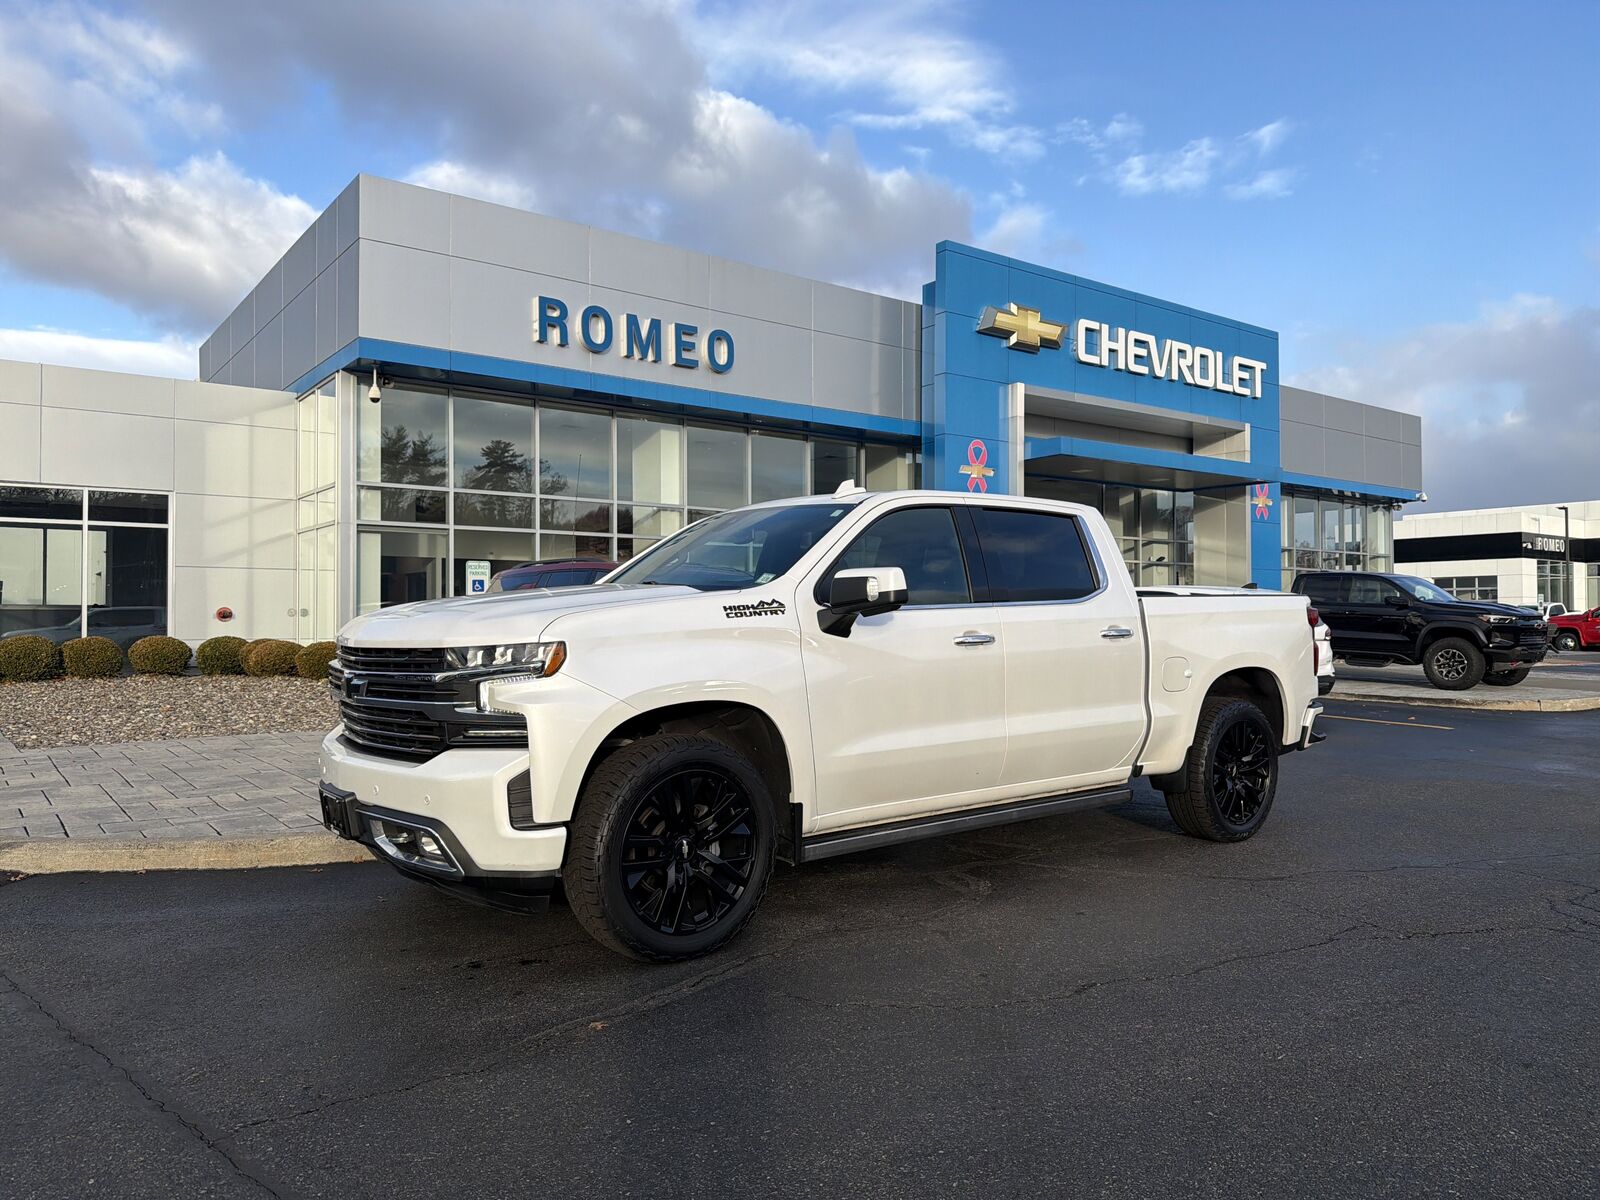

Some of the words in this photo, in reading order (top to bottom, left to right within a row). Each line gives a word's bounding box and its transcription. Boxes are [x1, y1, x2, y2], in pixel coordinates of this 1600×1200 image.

[533, 296, 735, 374] ROMEO
[1076, 318, 1267, 399] CHEVROLET
[1535, 537, 1565, 553] ROMEO
[723, 604, 755, 612] HIGH
[726, 609, 786, 619] COUNTRY
